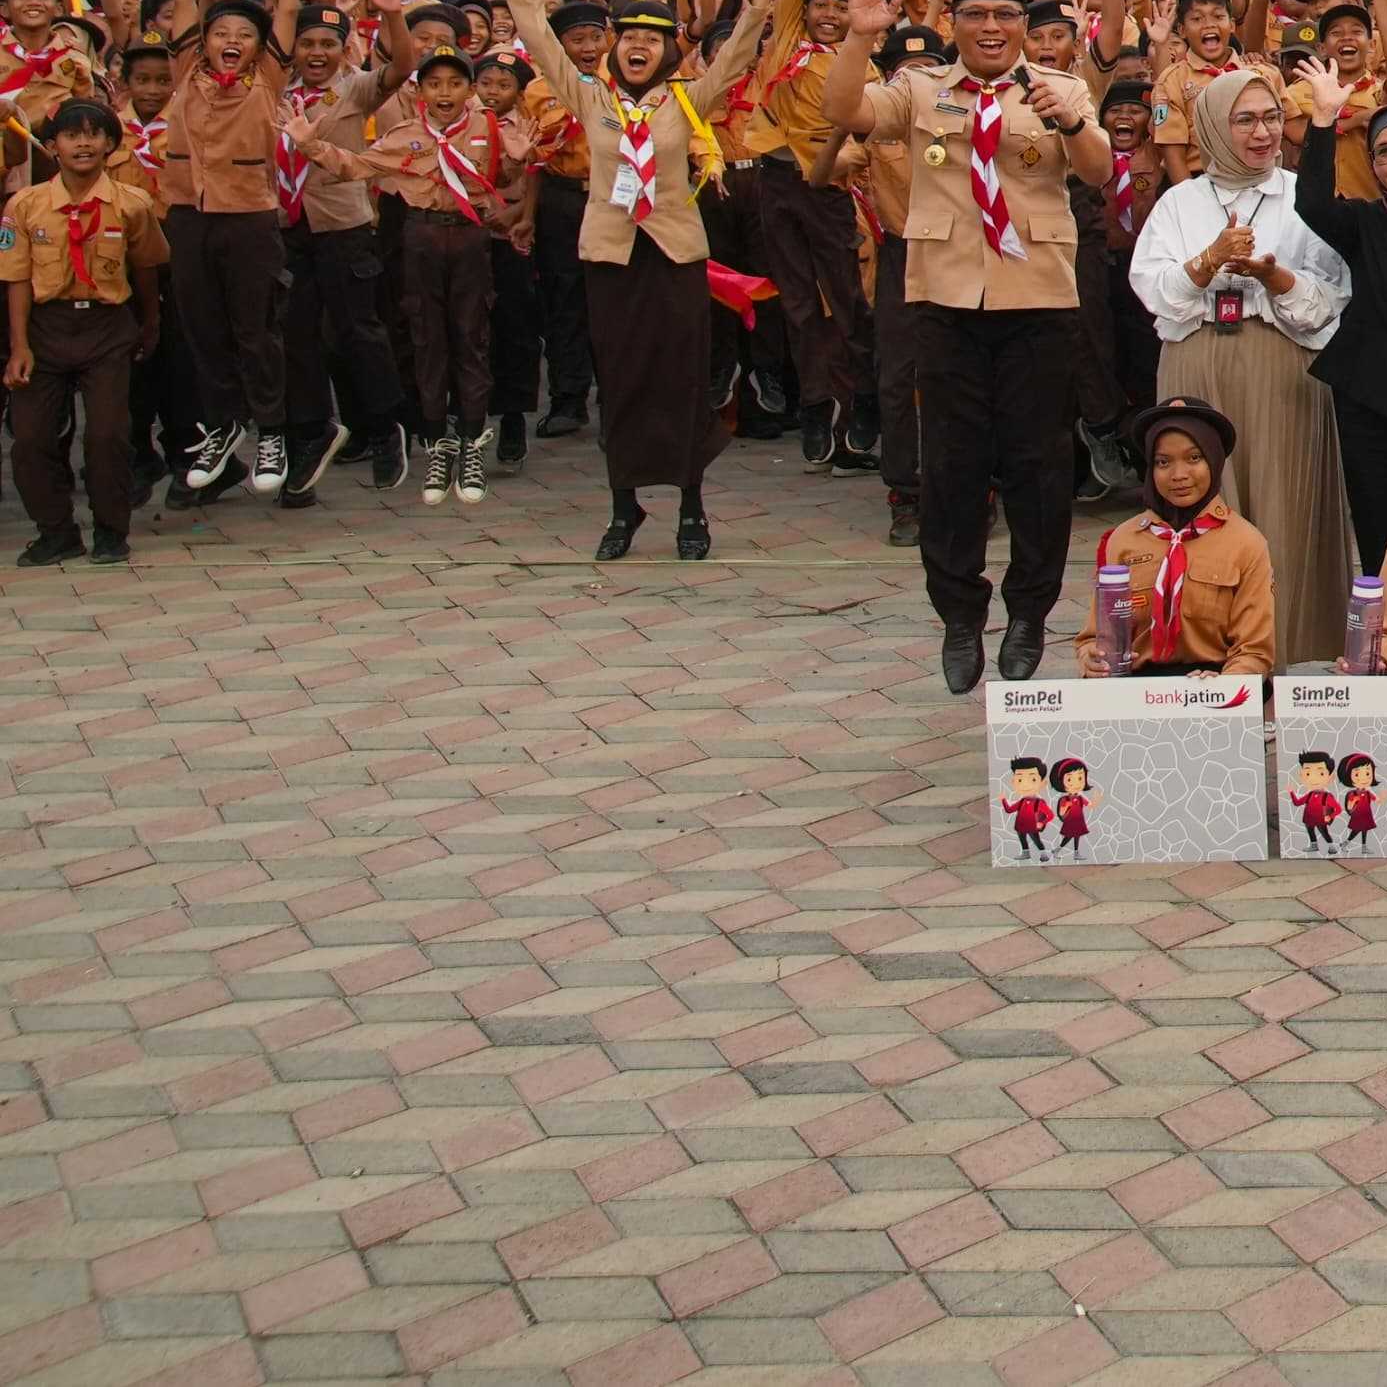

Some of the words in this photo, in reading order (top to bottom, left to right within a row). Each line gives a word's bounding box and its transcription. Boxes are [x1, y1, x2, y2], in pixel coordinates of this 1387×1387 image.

[1004, 690, 1063, 706] SimPel
[1145, 689, 1226, 707] bankjatim
[1292, 686, 1351, 701] SimPel
[1326, 700, 1351, 708] Pelajar
